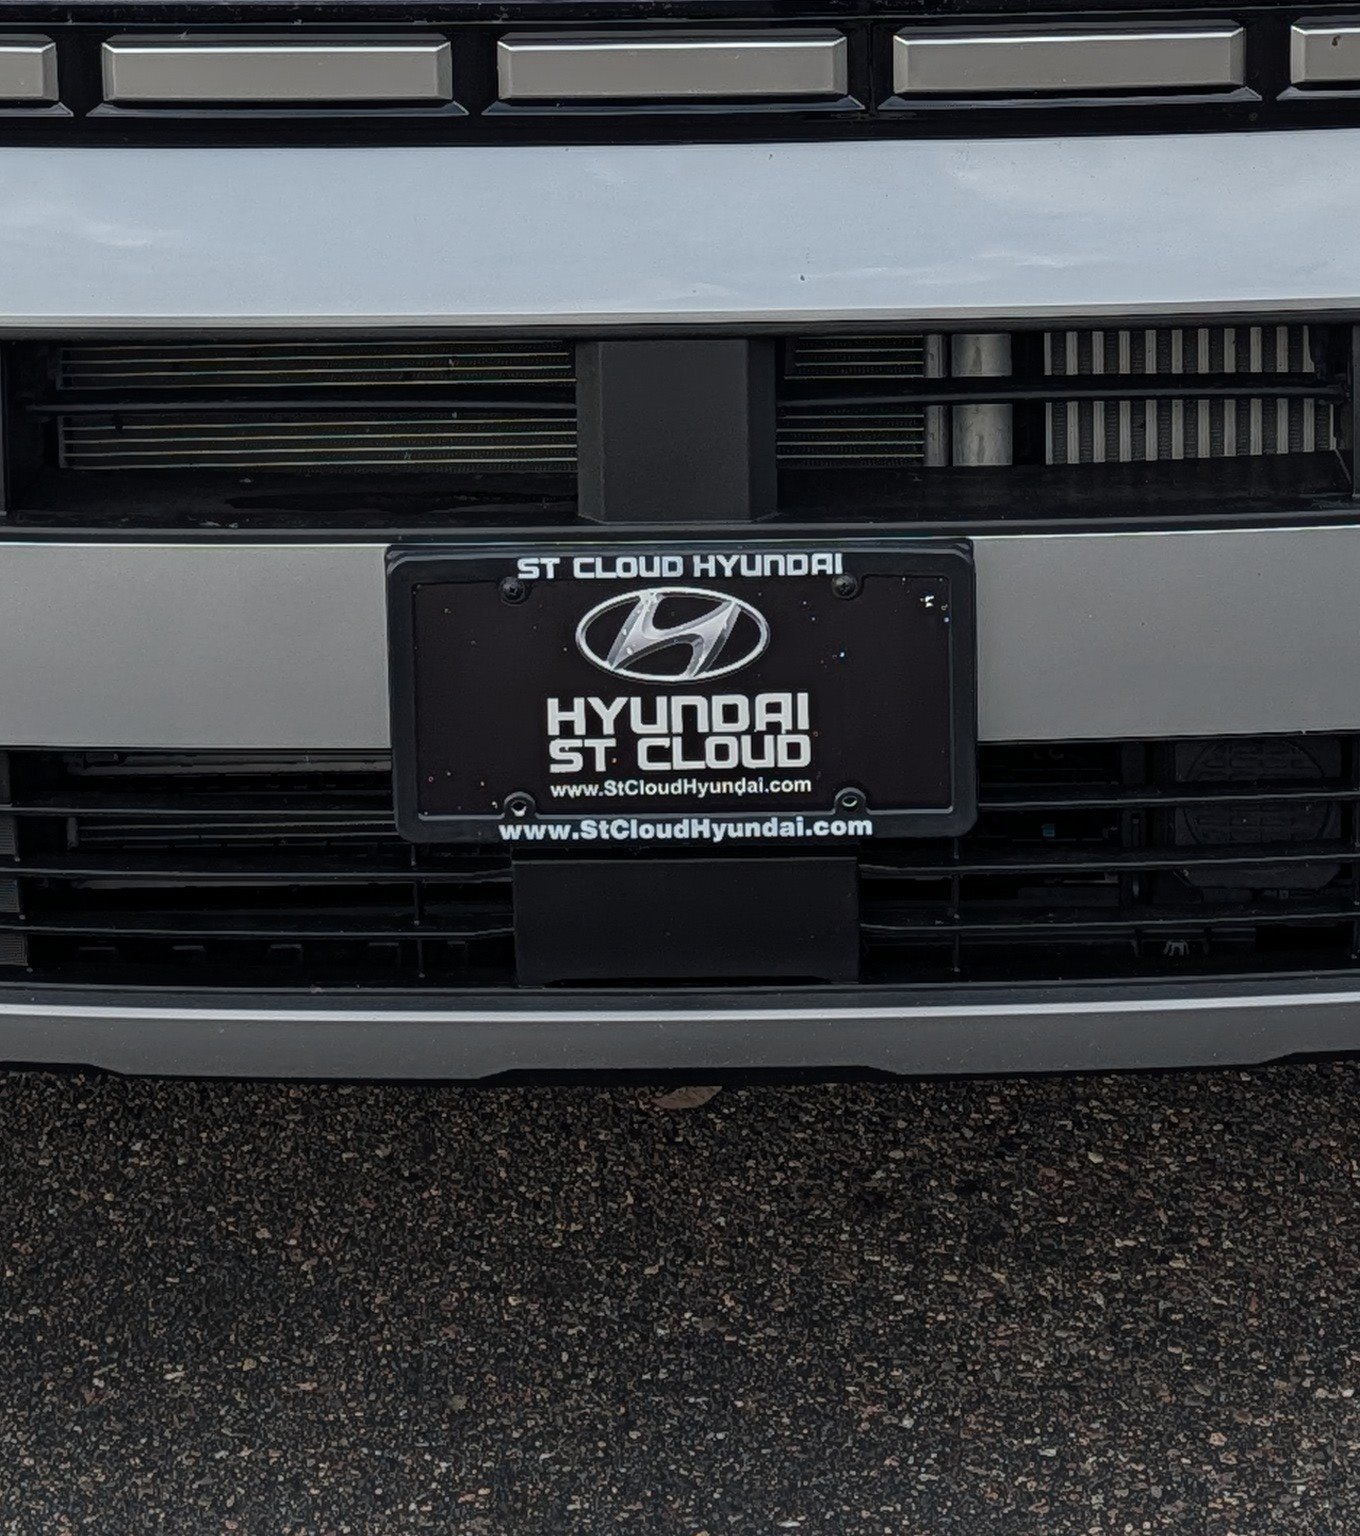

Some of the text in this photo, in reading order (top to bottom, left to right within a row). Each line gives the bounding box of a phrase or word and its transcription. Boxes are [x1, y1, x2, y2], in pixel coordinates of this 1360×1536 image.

[517, 552, 843, 580] ST CLOUD HYUNDAI
[547, 693, 810, 736] HYUNDAI
[549, 734, 811, 773] ST CLOUD
[551, 776, 812, 798] www.StCloudHyundai.com
[498, 816, 873, 842] www.StCloudHyundai.com
